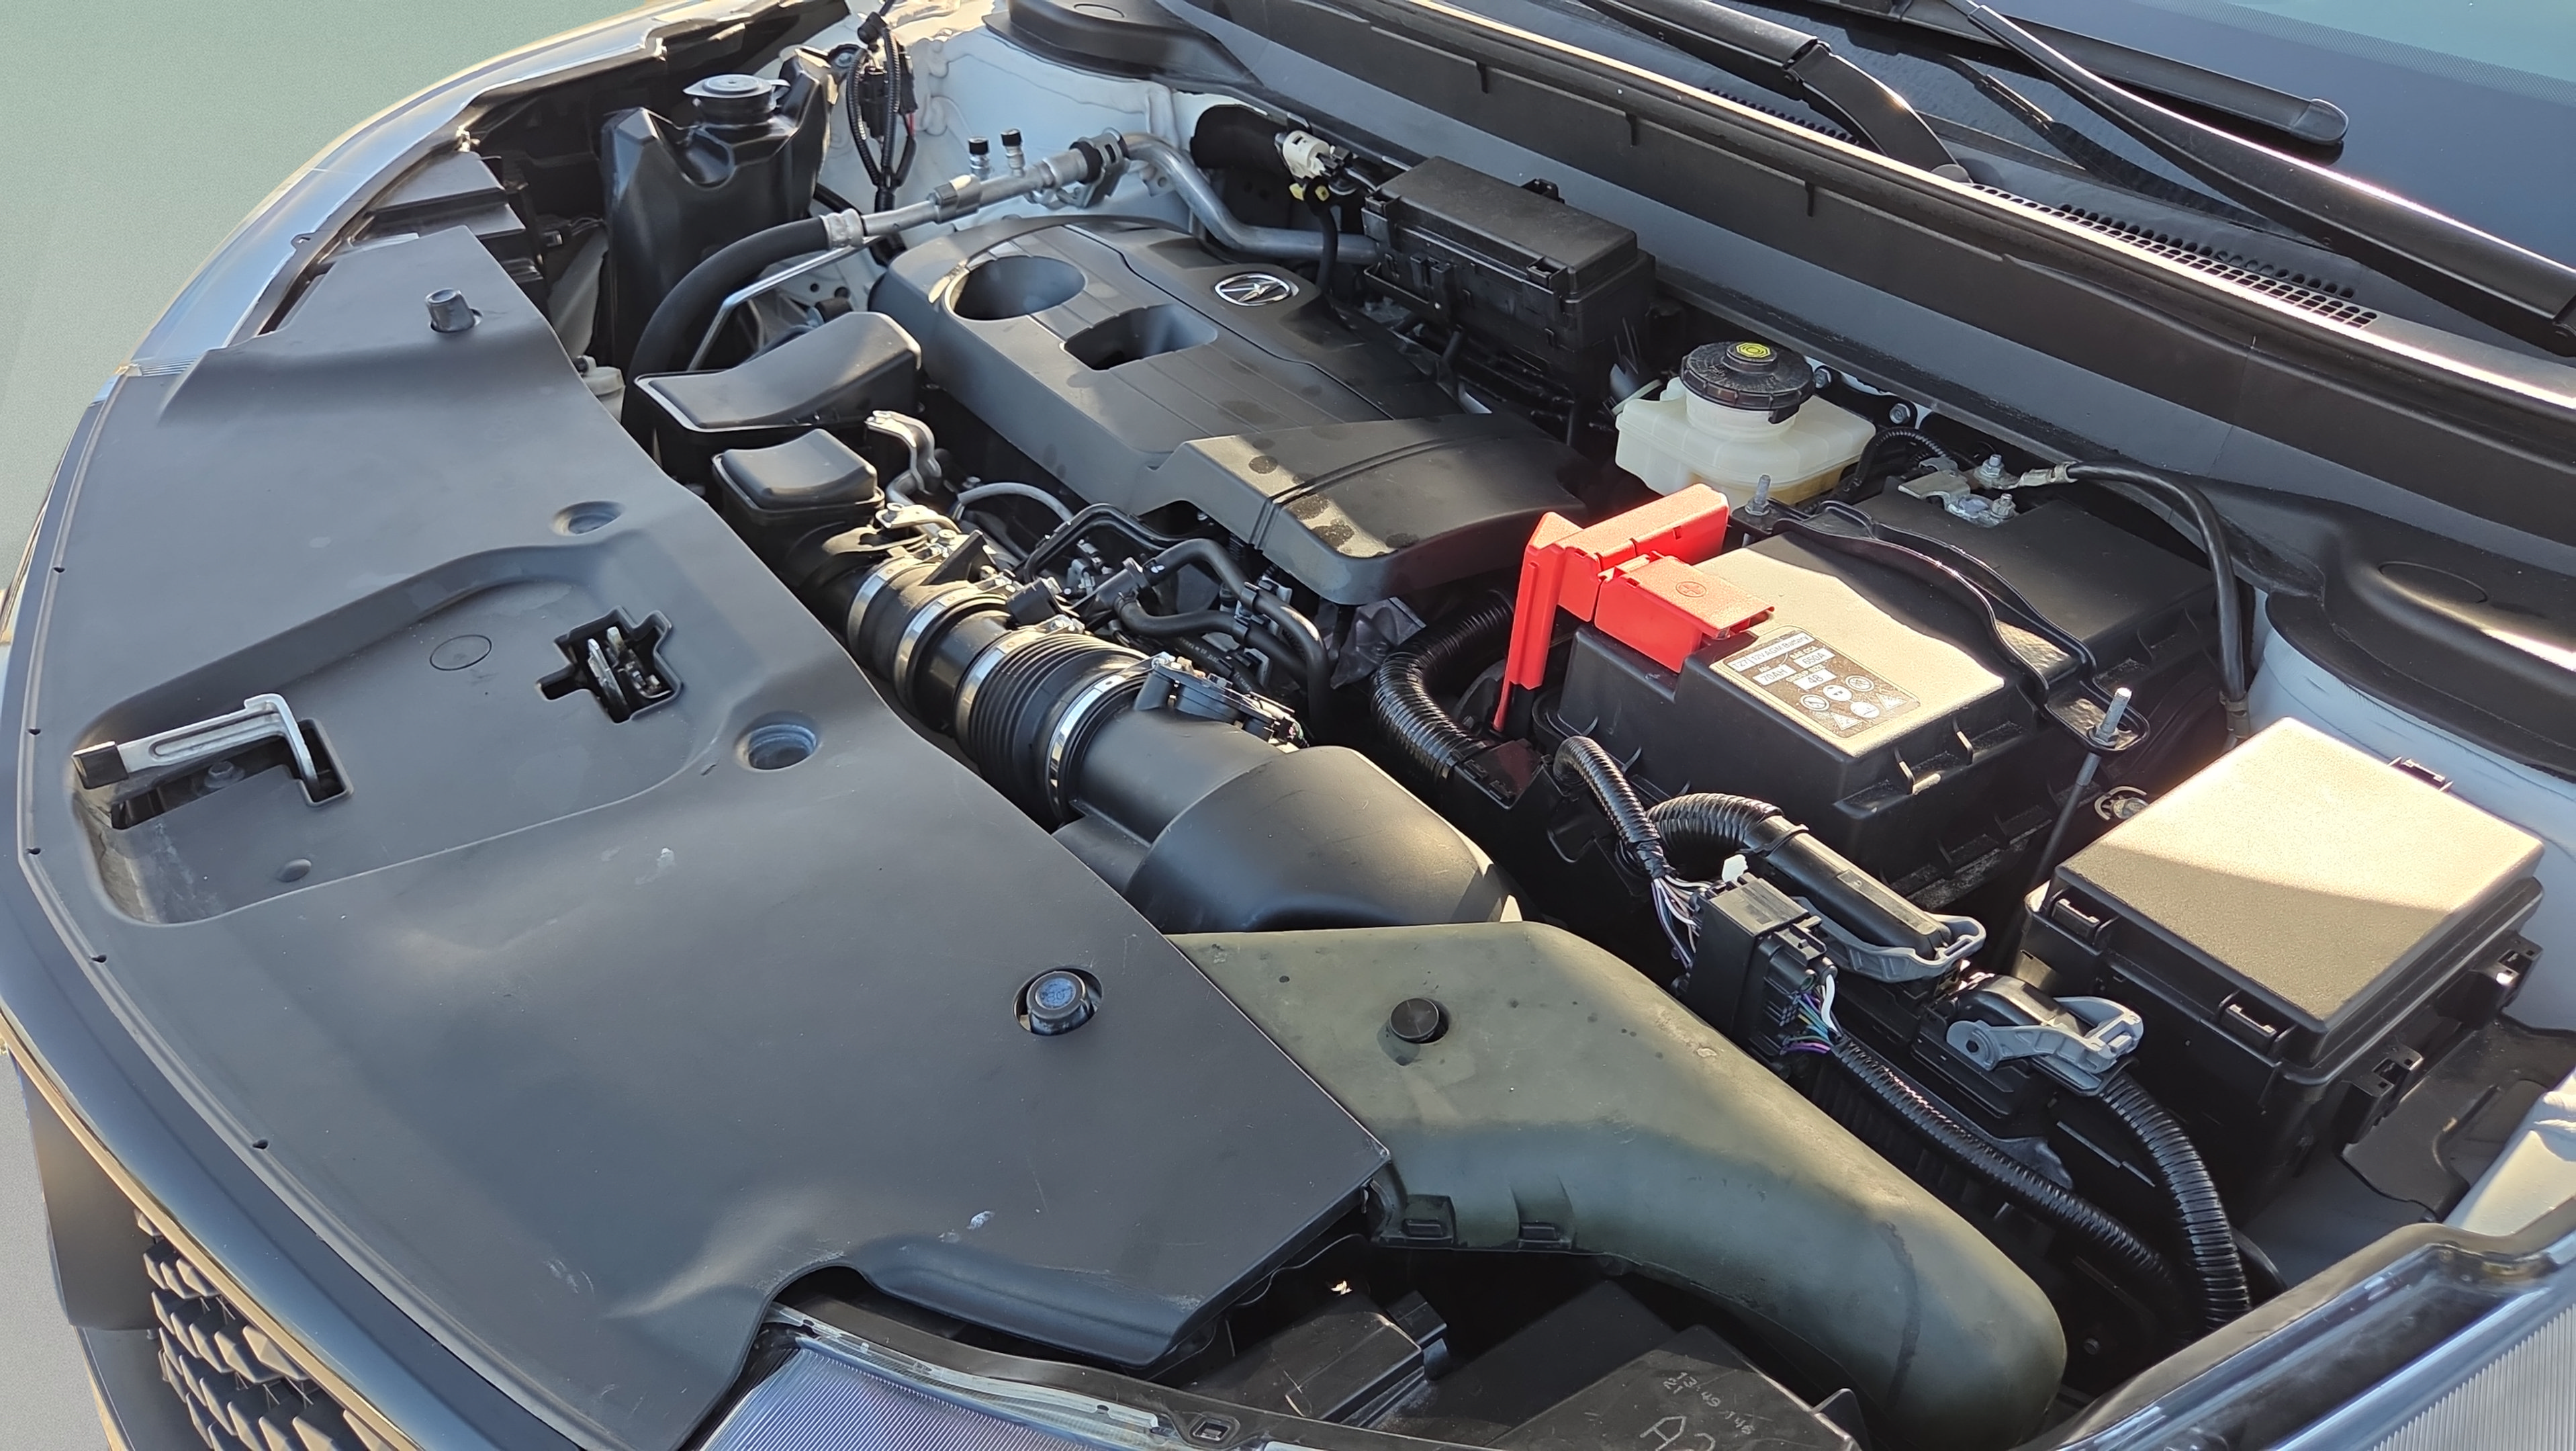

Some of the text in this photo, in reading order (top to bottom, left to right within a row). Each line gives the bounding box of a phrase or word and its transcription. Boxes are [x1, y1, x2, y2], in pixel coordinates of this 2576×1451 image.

[1732, 635, 1810, 668] TZ7 12V AGM Battery
[1804, 653, 1827, 664] 650A
[1761, 668, 1788, 682] 70AH
[1808, 674, 1824, 685] 48
